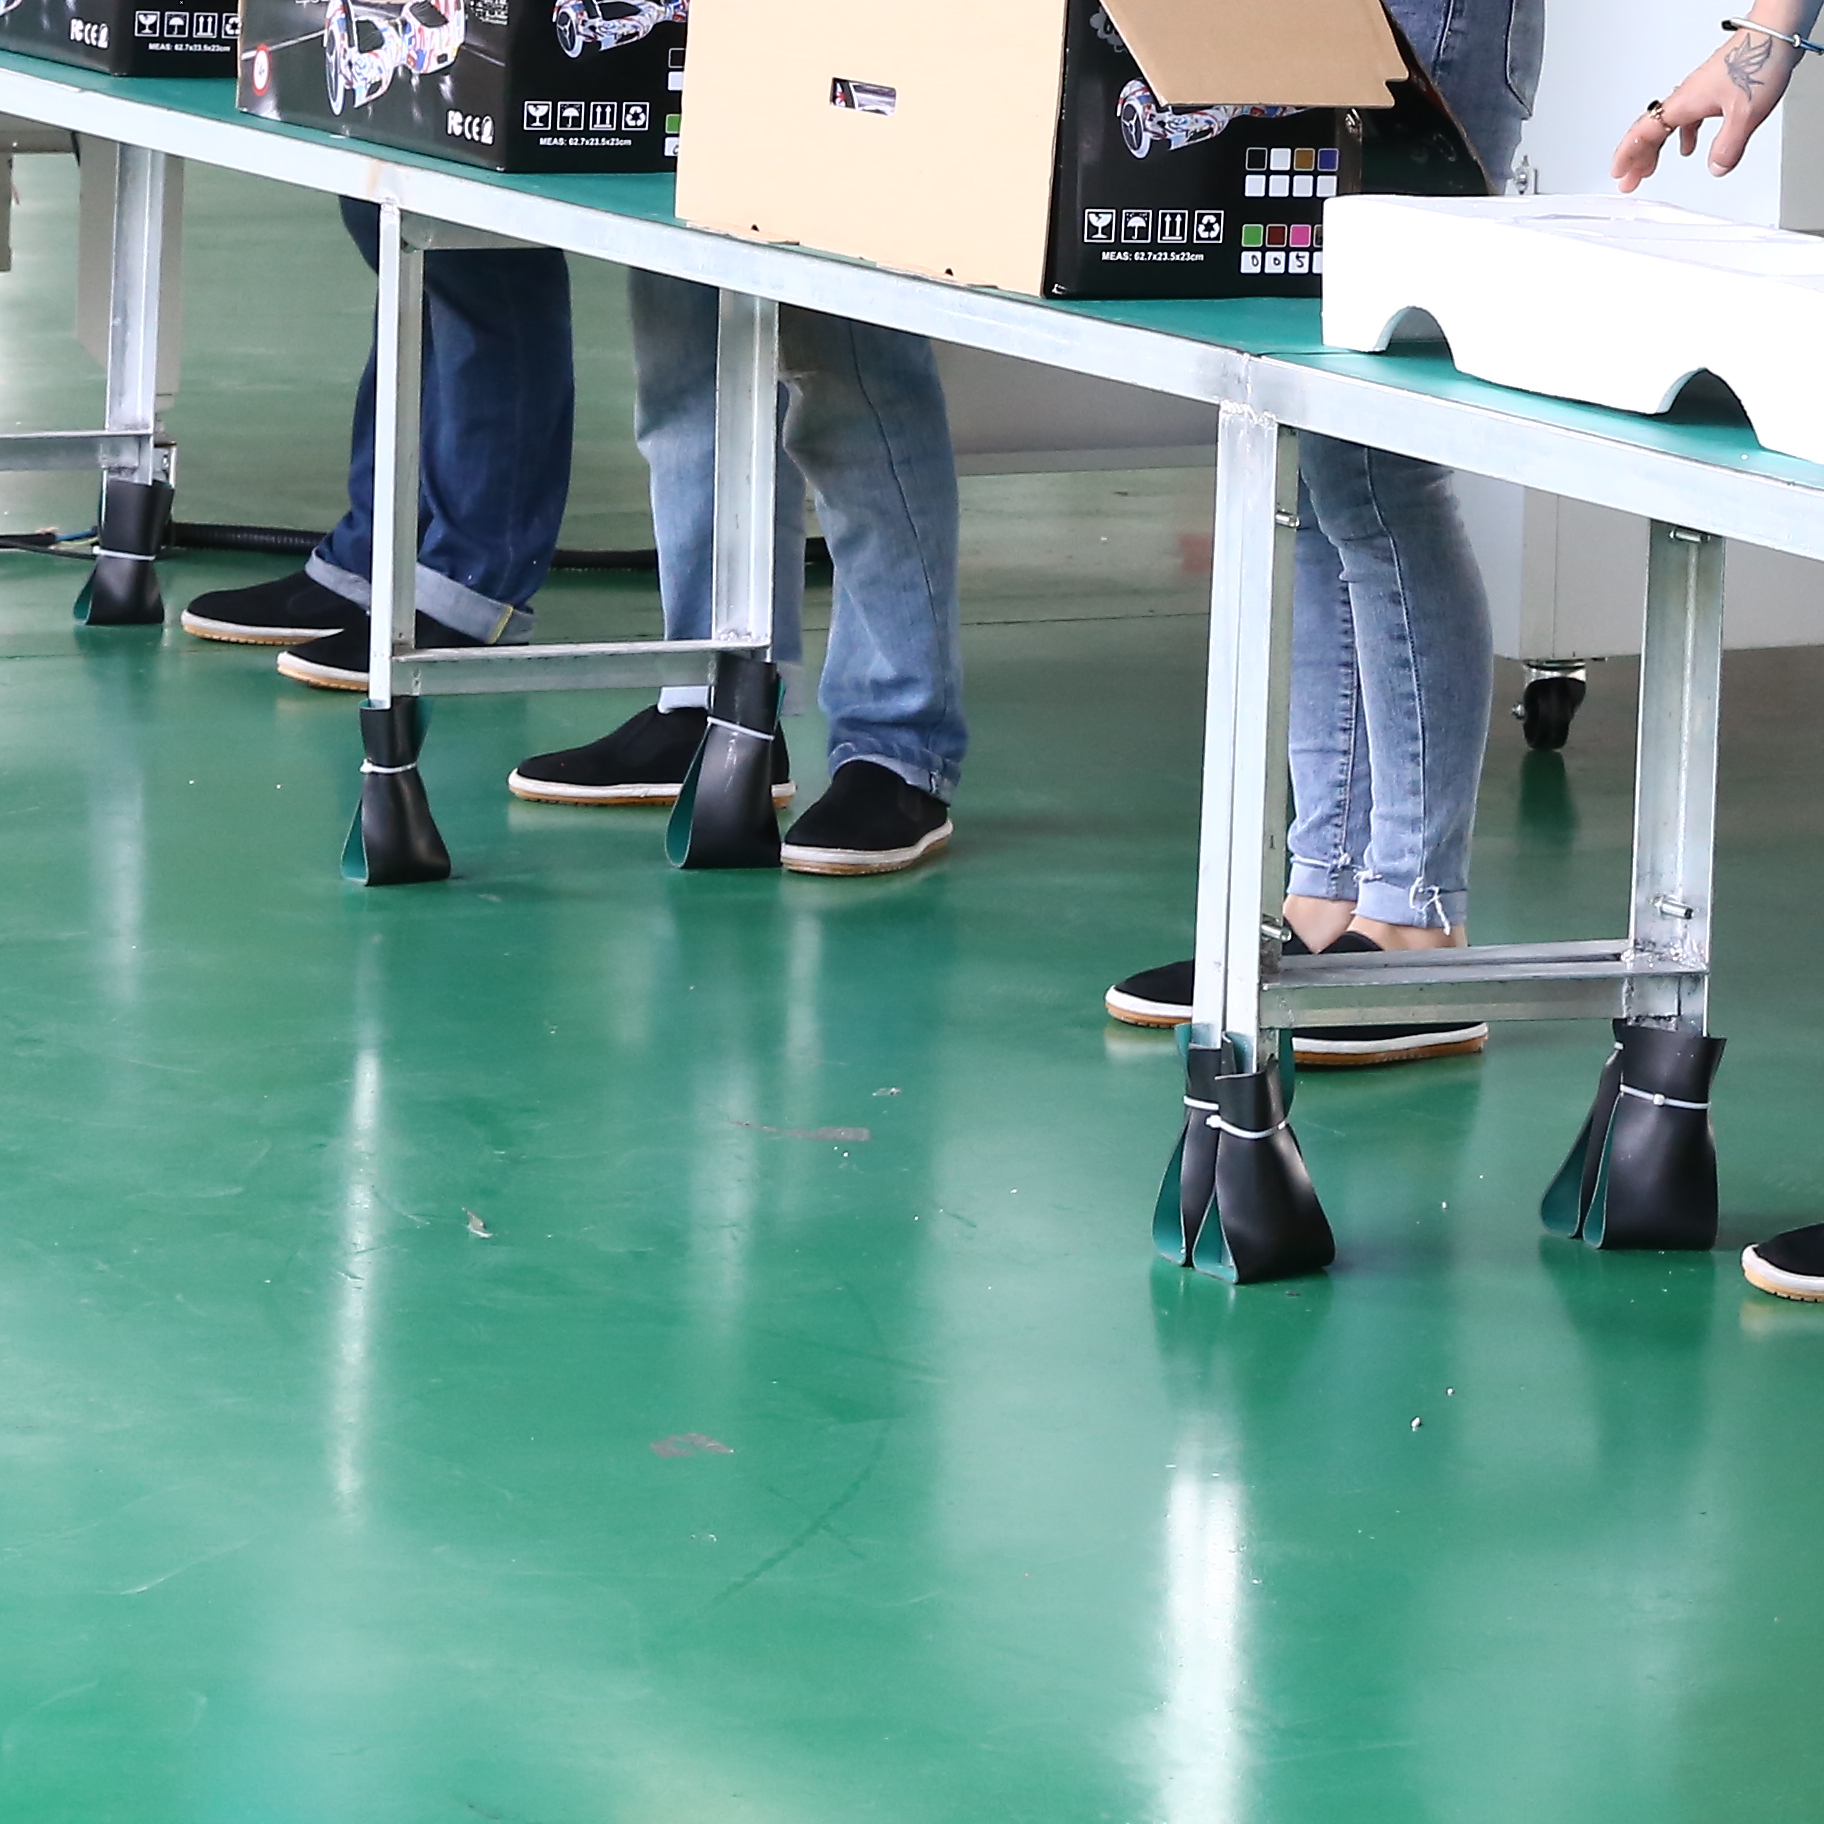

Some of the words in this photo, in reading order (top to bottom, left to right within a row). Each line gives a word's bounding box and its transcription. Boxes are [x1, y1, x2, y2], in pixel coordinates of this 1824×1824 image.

[148, 42, 173, 52] MEAS:
[539, 136, 567, 146] MEAS:
[568, 137, 632, 147] 62.7x23.5x23cm
[1101, 250, 1133, 262] MEAS:
[1134, 251, 1204, 262] 62.7x23.5x23cm
